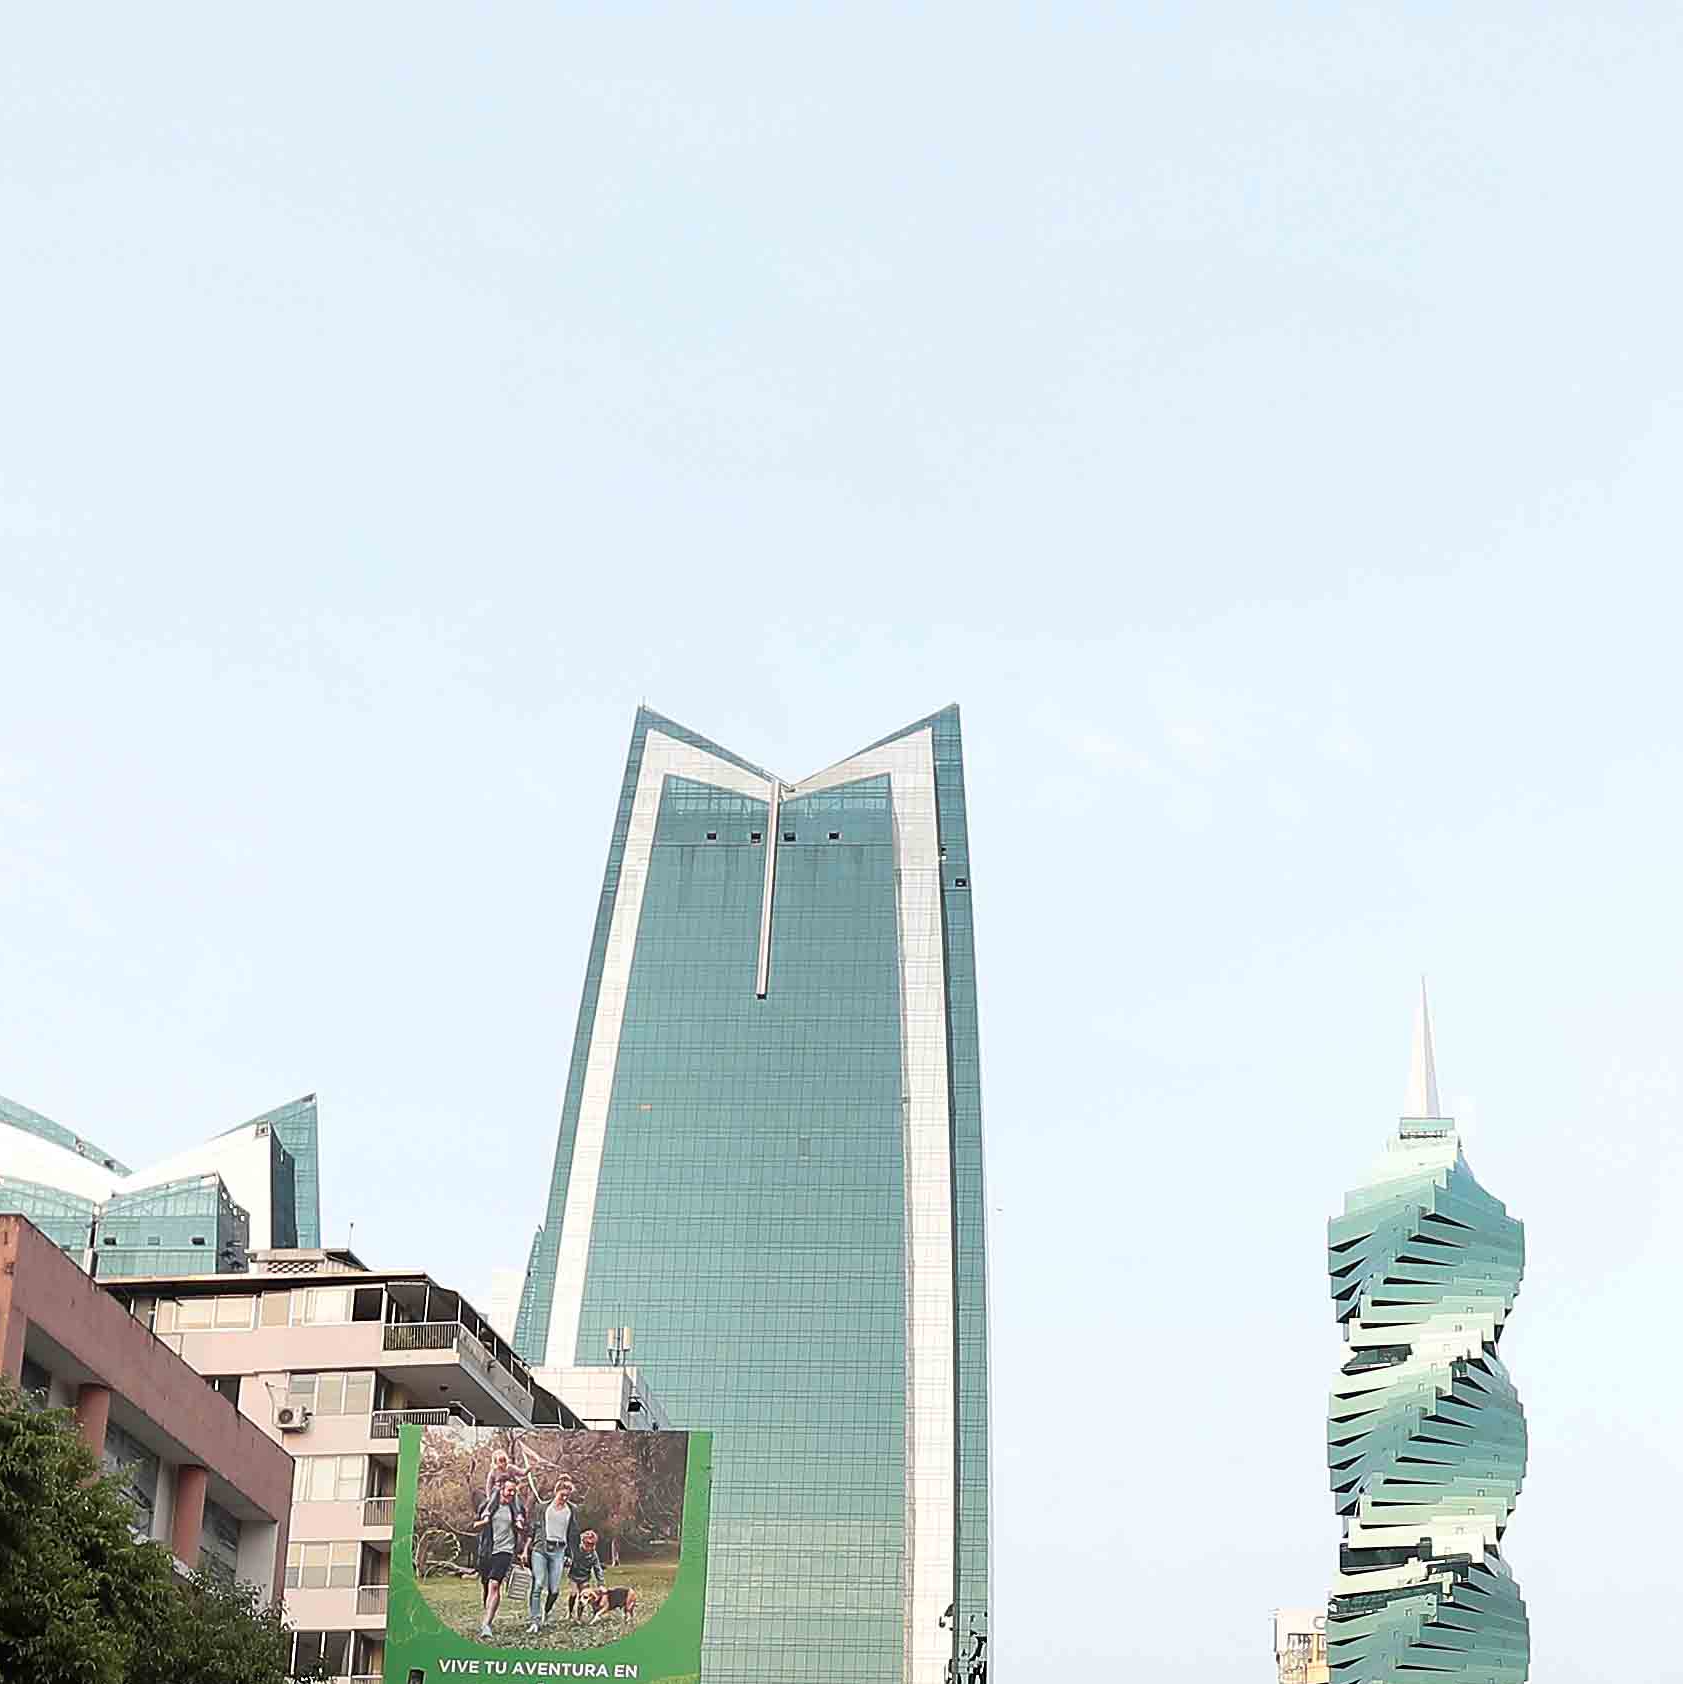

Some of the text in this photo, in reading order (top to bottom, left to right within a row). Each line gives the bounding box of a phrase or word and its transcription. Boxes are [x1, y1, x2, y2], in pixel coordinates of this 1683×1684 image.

[438, 1659, 638, 1678] VIVE TU AVENTURA EN
